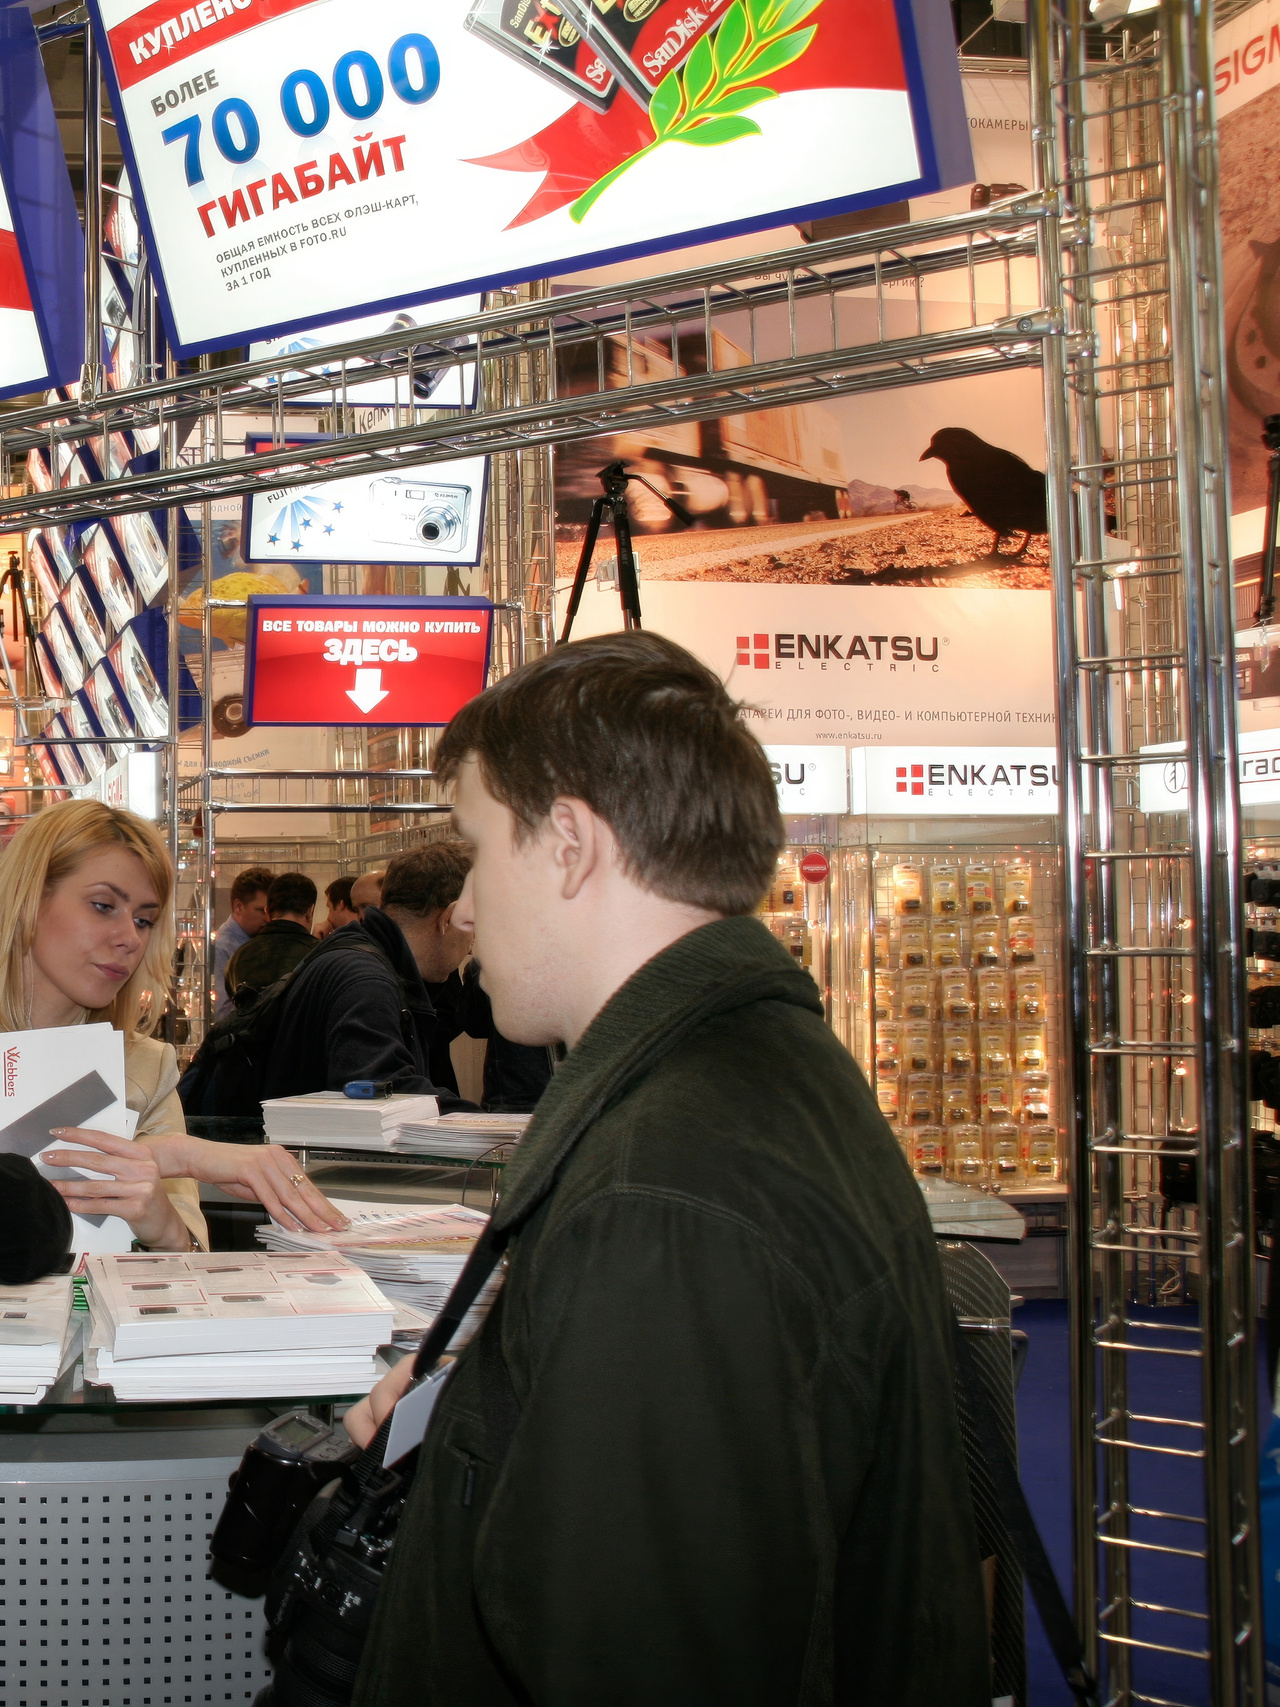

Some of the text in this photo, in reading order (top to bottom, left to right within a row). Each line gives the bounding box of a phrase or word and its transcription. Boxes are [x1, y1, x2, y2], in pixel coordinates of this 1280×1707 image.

[150, 68, 219, 118] БОЛЕЕ
[161, 32, 441, 188] 70 000
[197, 131, 407, 239] ГИГАБАЙТ
[215, 193, 420, 264] ОБЩАЯ ЕМКОСТЬ ВСЕХ ФЛЭШ-КАРТ,
[220, 226, 348, 278] КУПЛЕННЫХ В FOTO.RU
[225, 267, 271, 292] ЗА 1 ГОД
[262, 620, 481, 634] ВСЕ ТОВАРЫ МОЖНО КУПИТЬ
[323, 638, 419, 666] ЗДЕСЬ
[775, 633, 938, 662] ENKATSU
[775, 661, 939, 673] ELECTRIC
[735, 707, 782, 720] АТАРЕИ
[786, 708, 811, 722] ДЛЯ
[857, 710, 900, 722] ВИДЕО-
[904, 711, 913, 721] И
[916, 709, 1012, 724] КОМПЬЮТЕРНОЙ
[815, 731, 883, 741] www.enkatsu.ru
[6, 1046, 21, 1097] Webbers
